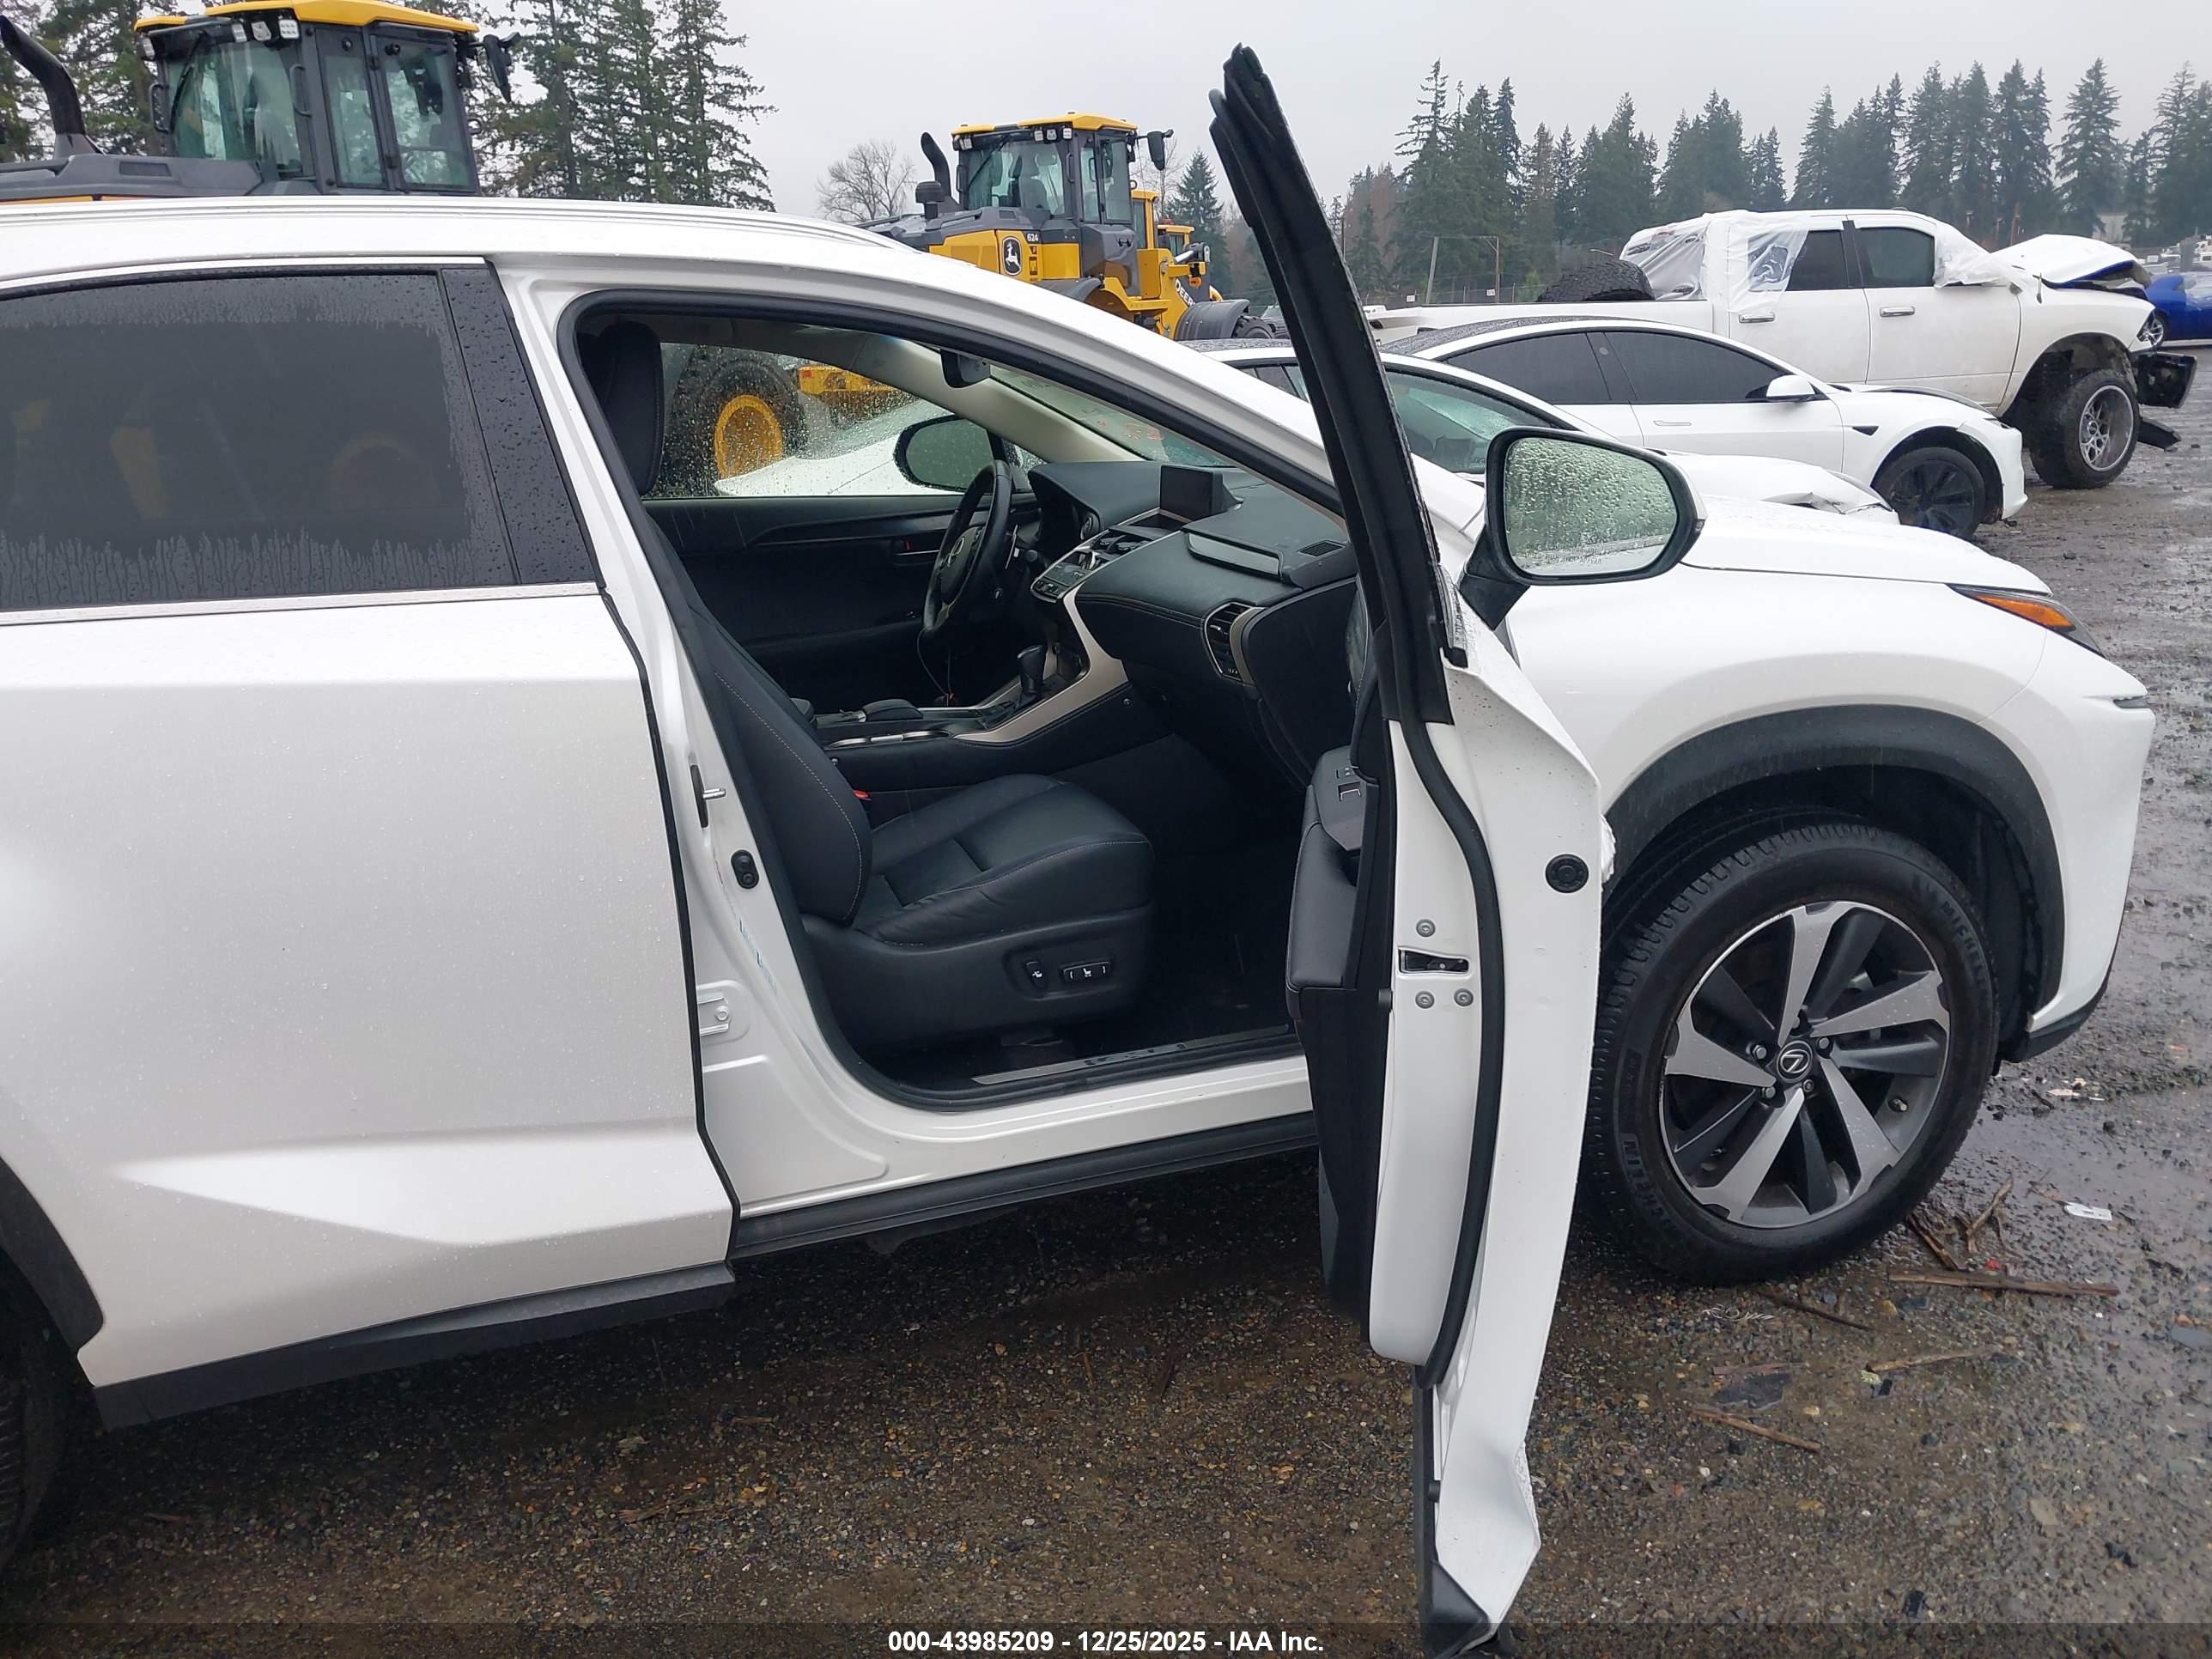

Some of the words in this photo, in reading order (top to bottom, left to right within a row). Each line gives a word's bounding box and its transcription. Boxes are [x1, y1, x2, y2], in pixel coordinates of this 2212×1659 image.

[1027, 233, 1039, 242] 624
[1176, 278, 1196, 307] DEER
[1623, 1140, 1678, 1238] ICHELIN
